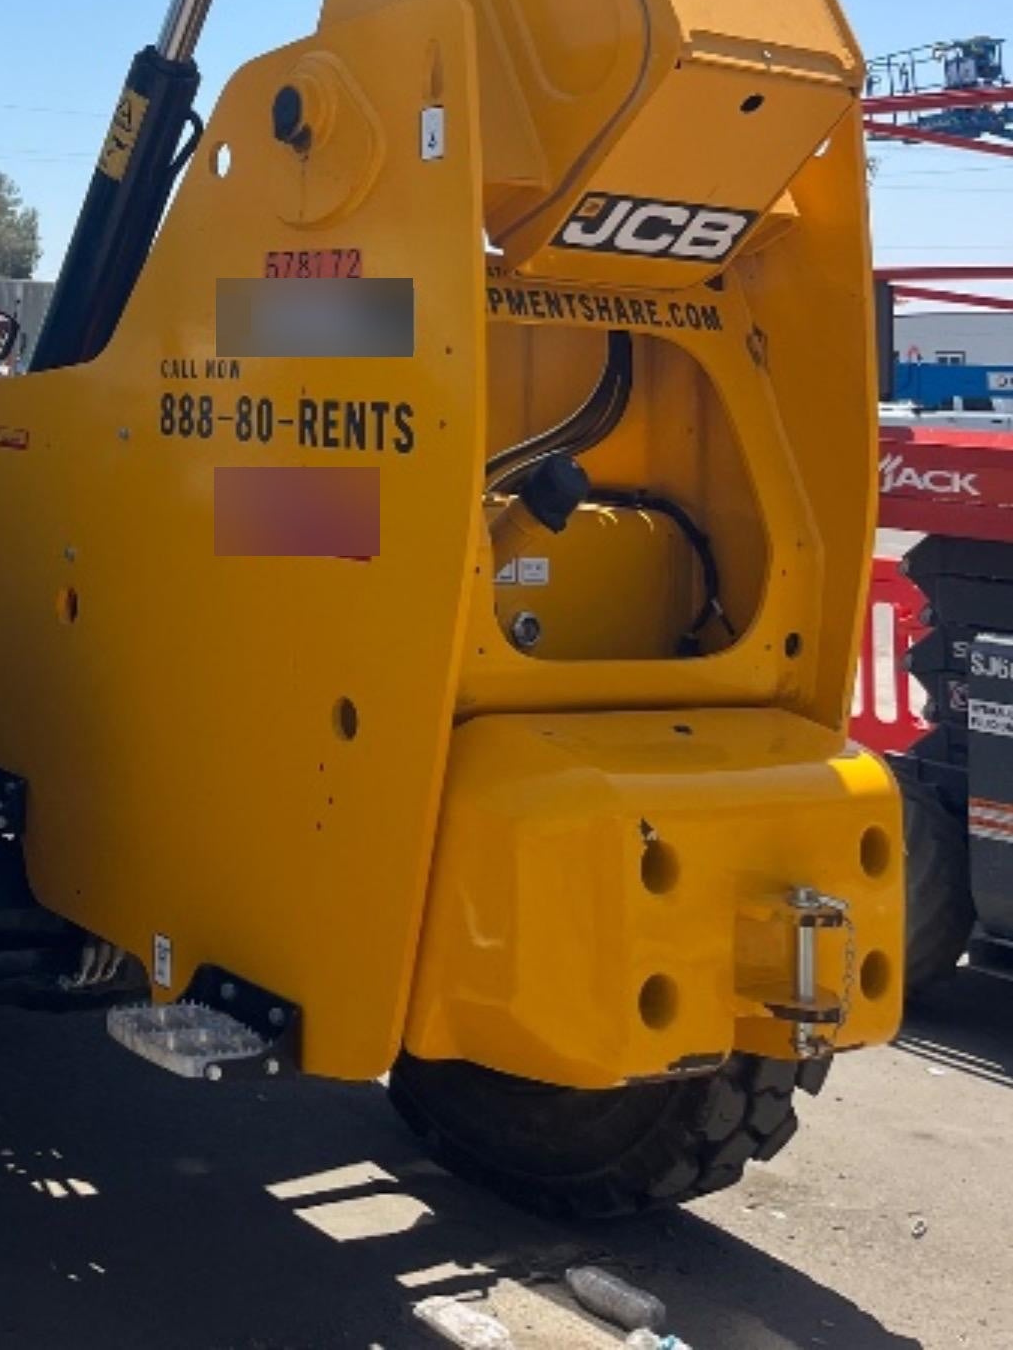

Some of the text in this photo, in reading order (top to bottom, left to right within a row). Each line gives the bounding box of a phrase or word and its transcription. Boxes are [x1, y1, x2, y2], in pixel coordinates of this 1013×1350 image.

[561, 199, 748, 260] JCB
[486, 287, 723, 331] PMENTSHARE.COM
[161, 359, 198, 379] CALL
[160, 392, 415, 454] 888-80-RENTS
[879, 454, 982, 496] JACK
